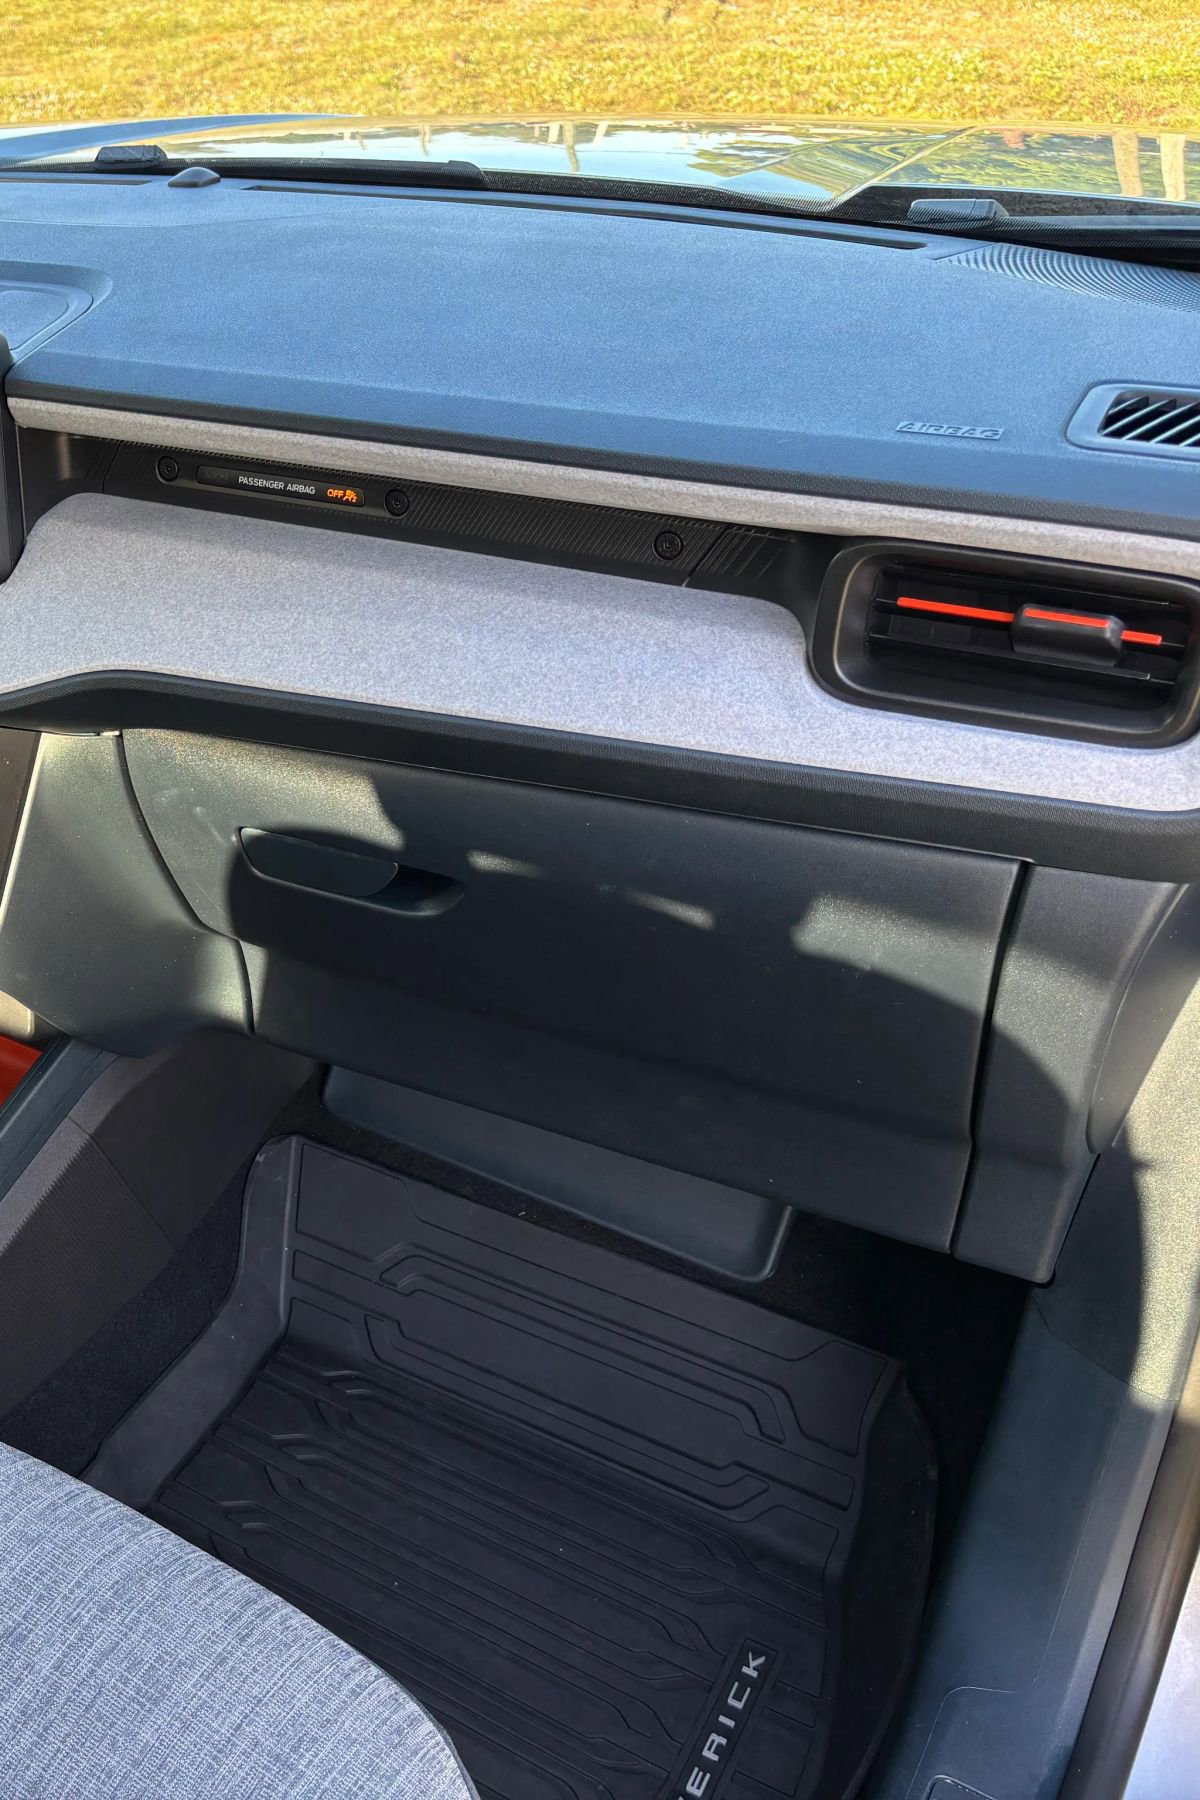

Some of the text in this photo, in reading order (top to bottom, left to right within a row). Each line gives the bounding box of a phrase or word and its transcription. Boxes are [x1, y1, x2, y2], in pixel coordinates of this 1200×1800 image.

[899, 422, 1000, 438] AIRBAG
[238, 475, 344, 499] PASSENGER AIRBAG OFF
[678, 1651, 767, 1800] ERICK
